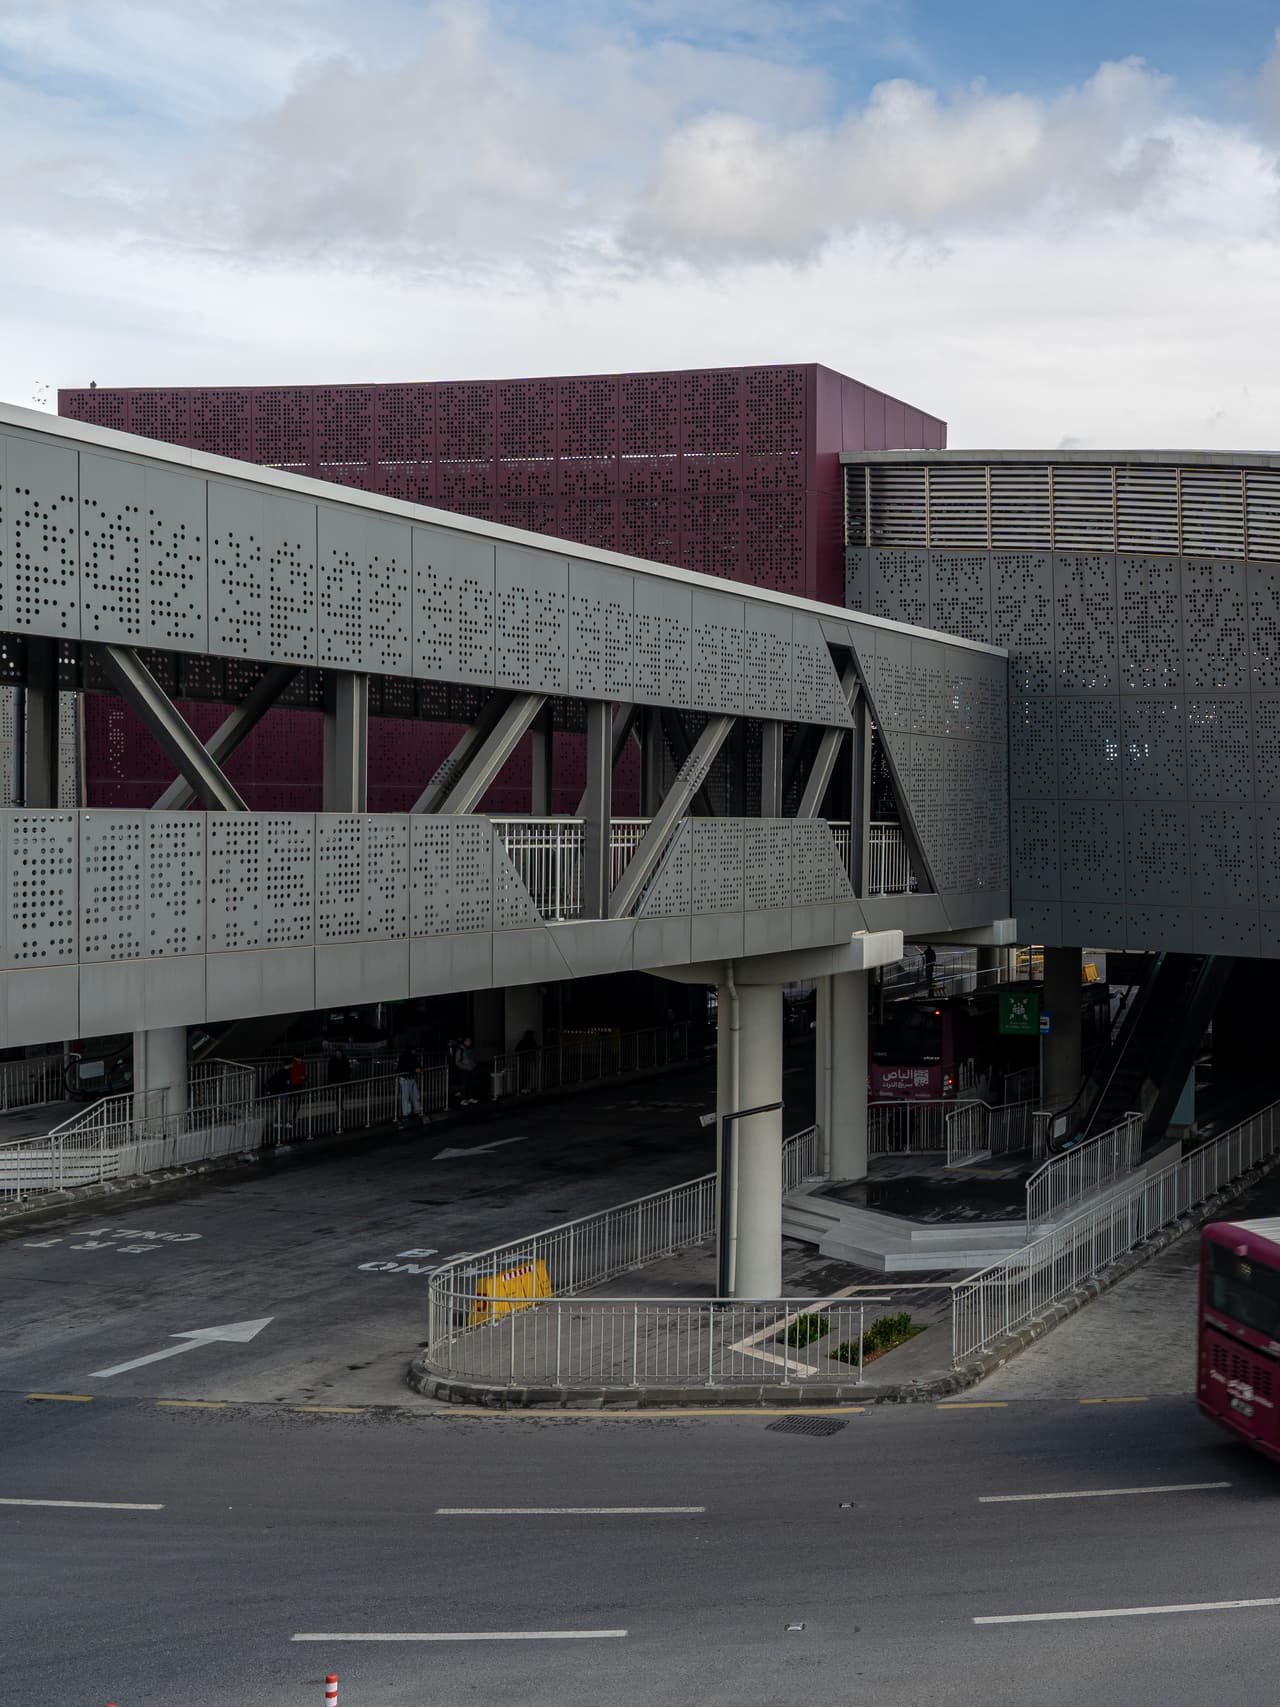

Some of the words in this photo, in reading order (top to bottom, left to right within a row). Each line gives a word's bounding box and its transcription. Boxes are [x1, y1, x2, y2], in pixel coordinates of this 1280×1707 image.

[883, 1068, 913, 1082] الباص
[69, 1228, 203, 1243] ONLY
[24, 1239, 164, 1254] BRT
